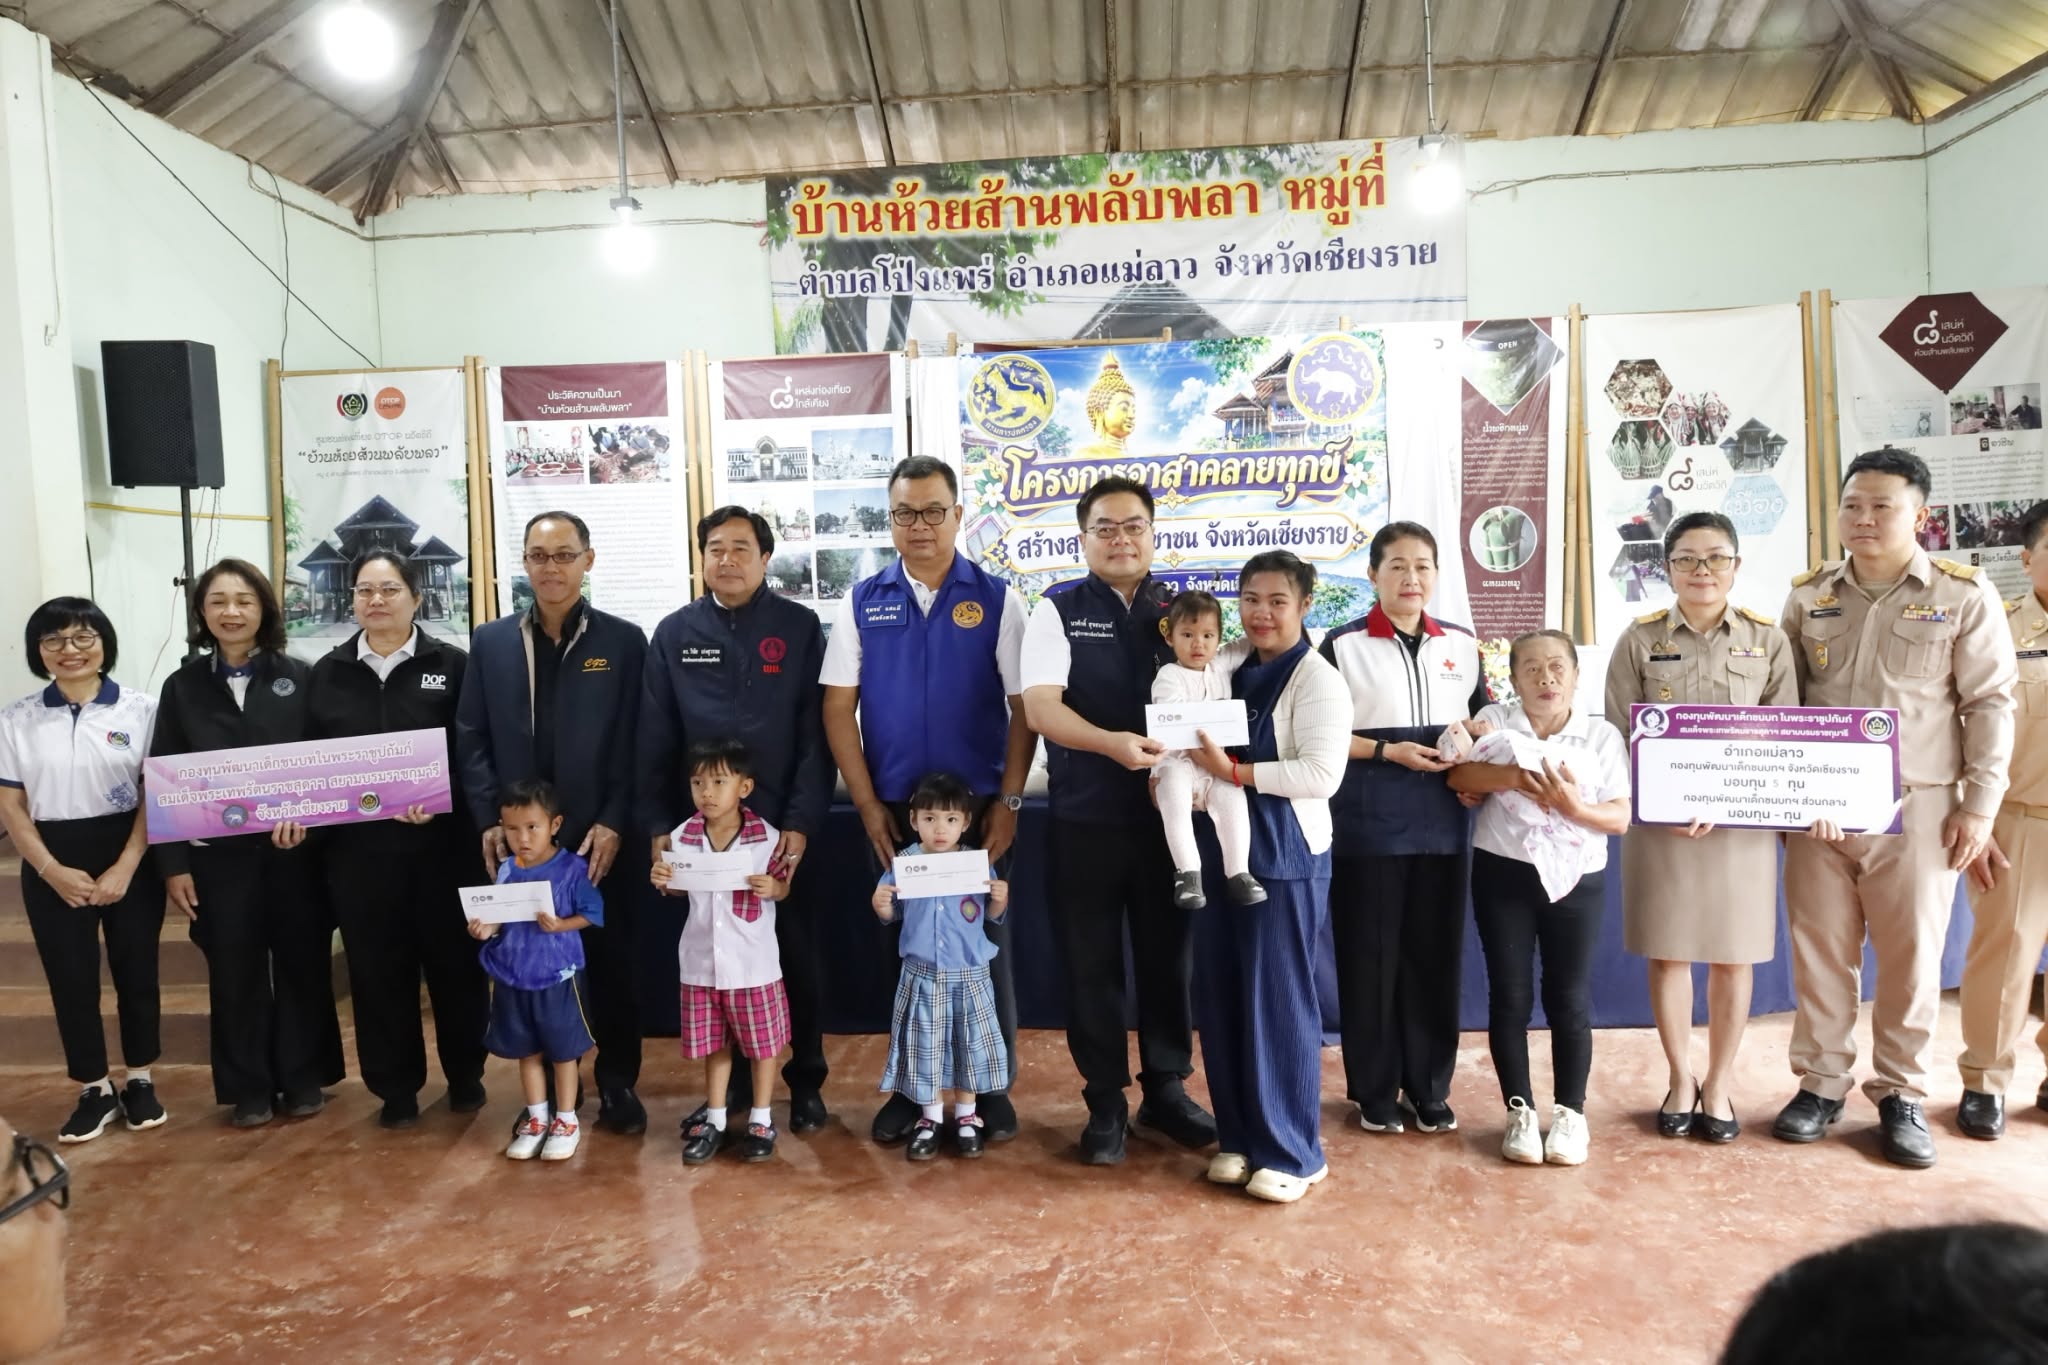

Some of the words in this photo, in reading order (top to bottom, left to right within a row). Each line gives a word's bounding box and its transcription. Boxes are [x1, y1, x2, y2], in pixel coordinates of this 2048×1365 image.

[792, 172, 1258, 235] บ้านห้วยส้านพลับพลา
[1284, 142, 1384, 227] หมู่ที่
[800, 255, 993, 295] ตำบลโป่งแพร่
[1010, 248, 1197, 292] อำเภอแม่ลาว
[1214, 239, 1438, 278] จังหวัดเชียงราย
[1498, 340, 1518, 350] OPEN
[547, 388, 622, 400] ประวัติความเป็นมา
[795, 381, 851, 396] แหล่งท่องเที่ยว
[795, 398, 829, 409] ใกล้เคียง
[374, 432, 403, 441] OTOP
[1004, 437, 1353, 508] โครงการอาสาคลายทุกข์
[1205, 520, 1348, 548] จังหวัดเชียงราย
[421, 673, 446, 685] DOP
[1675, 711, 1778, 723] กองทุนพัฒนาเด็กชนบท
[1780, 712, 1852, 726] ในพระราชูปถัมภ์
[1781, 728, 1849, 738] สยามบรมราชกุมารี
[1724, 744, 1803, 759] อำเภอแม่ลาว
[1670, 760, 1785, 774] กองทุนพัฒนาเด็กชนบทฯ
[1788, 763, 1859, 775] จังหวัดเชียงราย
[158, 778, 326, 806] สมเด็จพระเทพรัตนราชสุดาฯ
[329, 762, 440, 789] สยามบรมราชกุมารี
[1724, 777, 1766, 791] มอบทุน
[1773, 779, 1779, 788] 5
[1788, 779, 1805, 792] ทุน
[1683, 792, 1799, 806] กองทุนพัฒนาเด็กชนบทฯ
[1802, 796, 1847, 807] ส่วนกลาง
[256, 799, 348, 821] จังหวัดเชียงราย
[1728, 809, 1770, 822] มอบทุน
[1784, 810, 1801, 823] ทุน
